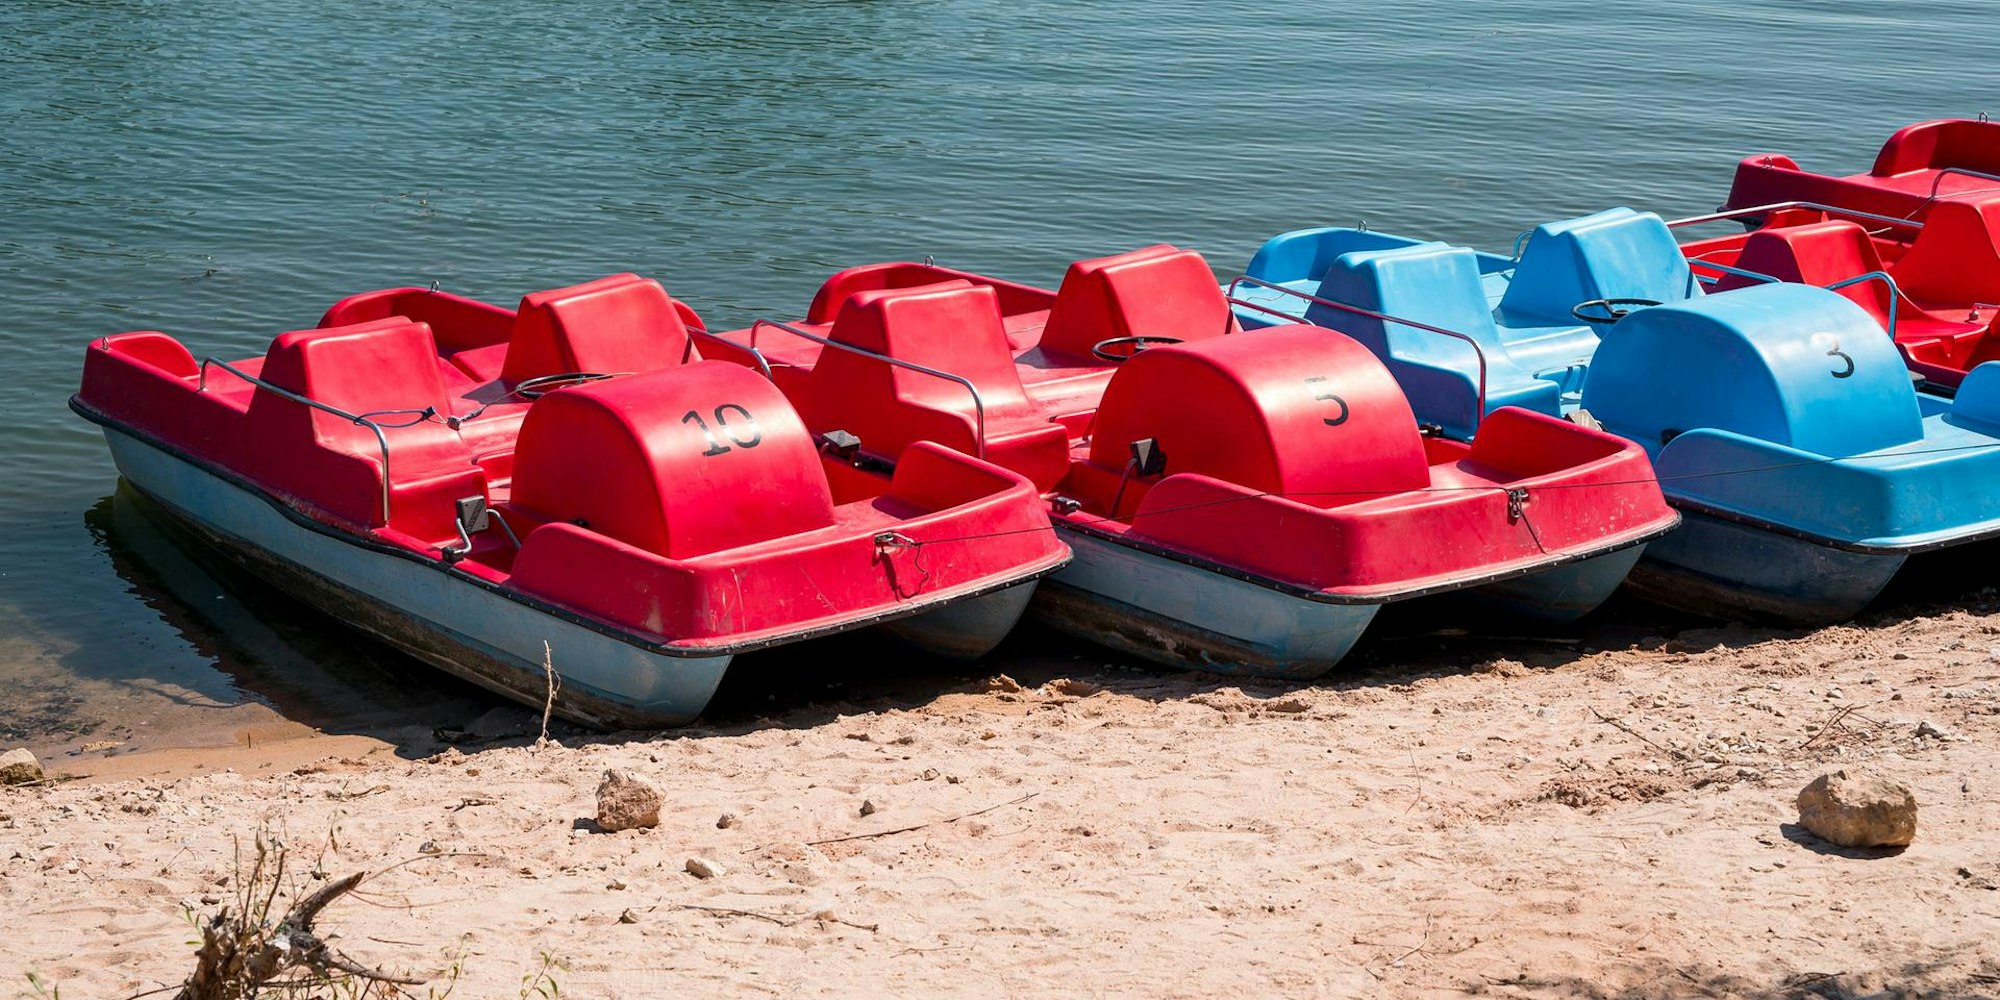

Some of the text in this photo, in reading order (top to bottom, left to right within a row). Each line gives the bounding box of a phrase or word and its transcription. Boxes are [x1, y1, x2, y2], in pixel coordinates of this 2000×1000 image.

[1811, 332, 1854, 378] 3
[1304, 376, 1349, 426] 5
[681, 403, 761, 457] 10
